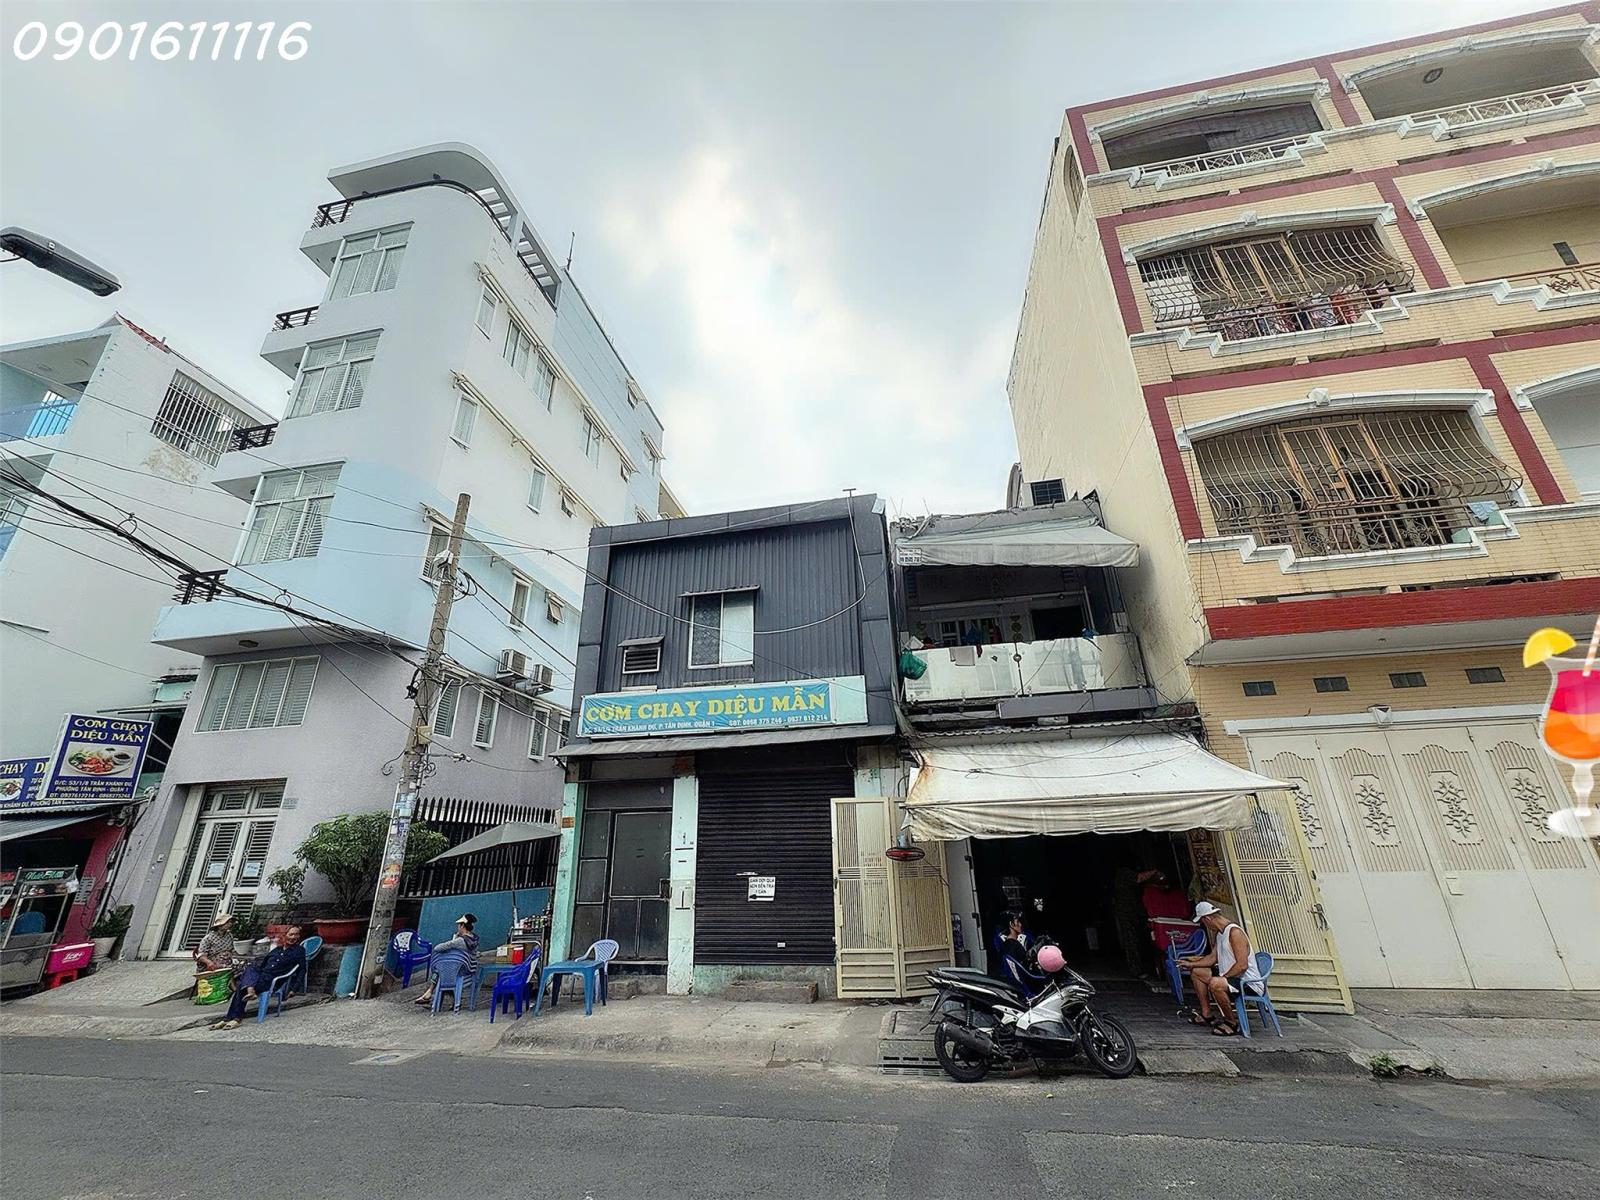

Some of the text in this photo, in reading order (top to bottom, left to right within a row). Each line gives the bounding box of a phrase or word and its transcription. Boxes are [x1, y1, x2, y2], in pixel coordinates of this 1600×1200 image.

[586, 686, 826, 721] CƠM CHAY DIỆU MẪN
[110, 721, 148, 733] CHAY
[70, 729, 145, 743] DIỆU MẪN
